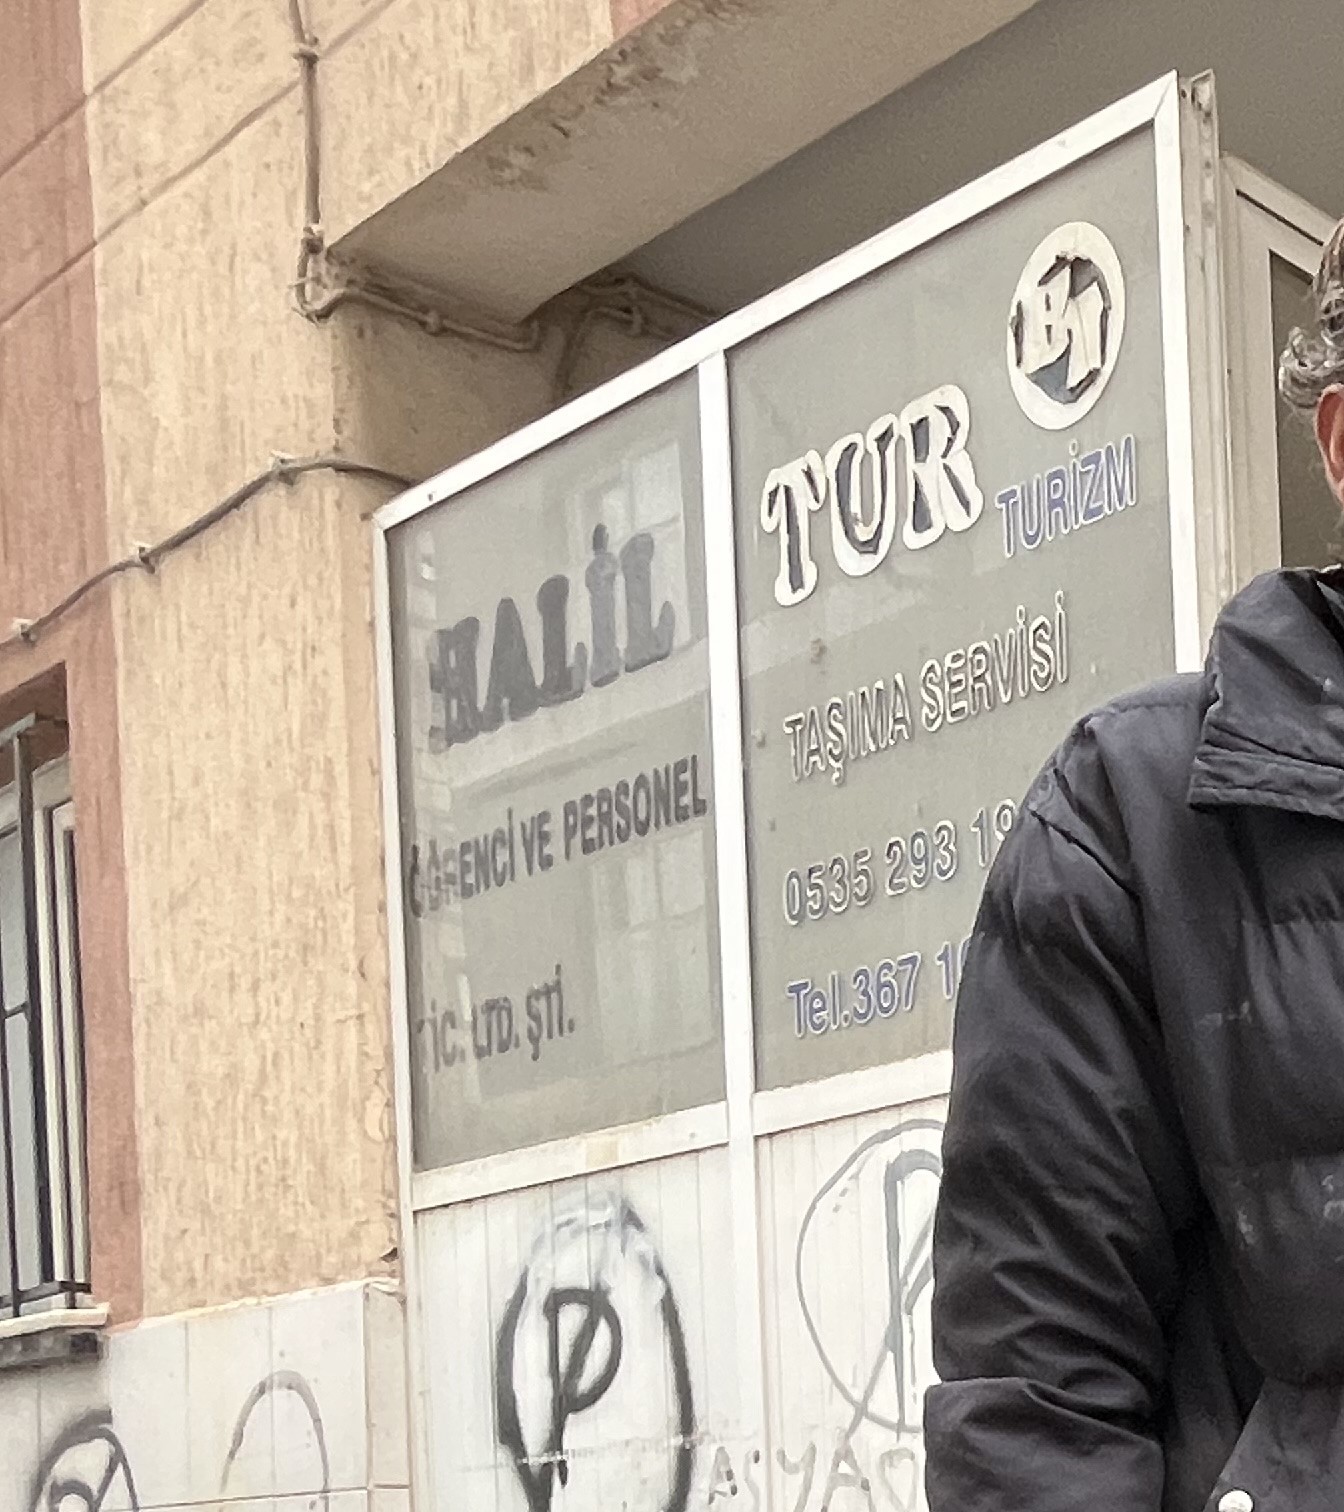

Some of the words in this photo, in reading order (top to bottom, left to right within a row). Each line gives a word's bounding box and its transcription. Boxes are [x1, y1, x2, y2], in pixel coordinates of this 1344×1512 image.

[428, 522, 676, 753] HALİL
[762, 385, 984, 606] TUR
[995, 434, 1137, 558] TURİZM
[410, 806, 515, 918] RENCİ
[520, 810, 554, 878] VE
[563, 754, 707, 861] PERSONEL
[784, 672, 911, 786] TAŞIMA
[920, 588, 1070, 732] SERVİSİ
[784, 848, 874, 926] 0535
[884, 819, 958, 898] 293
[524, 963, 576, 1062] ŞTİ.
[935, 935, 972, 1000] 1
